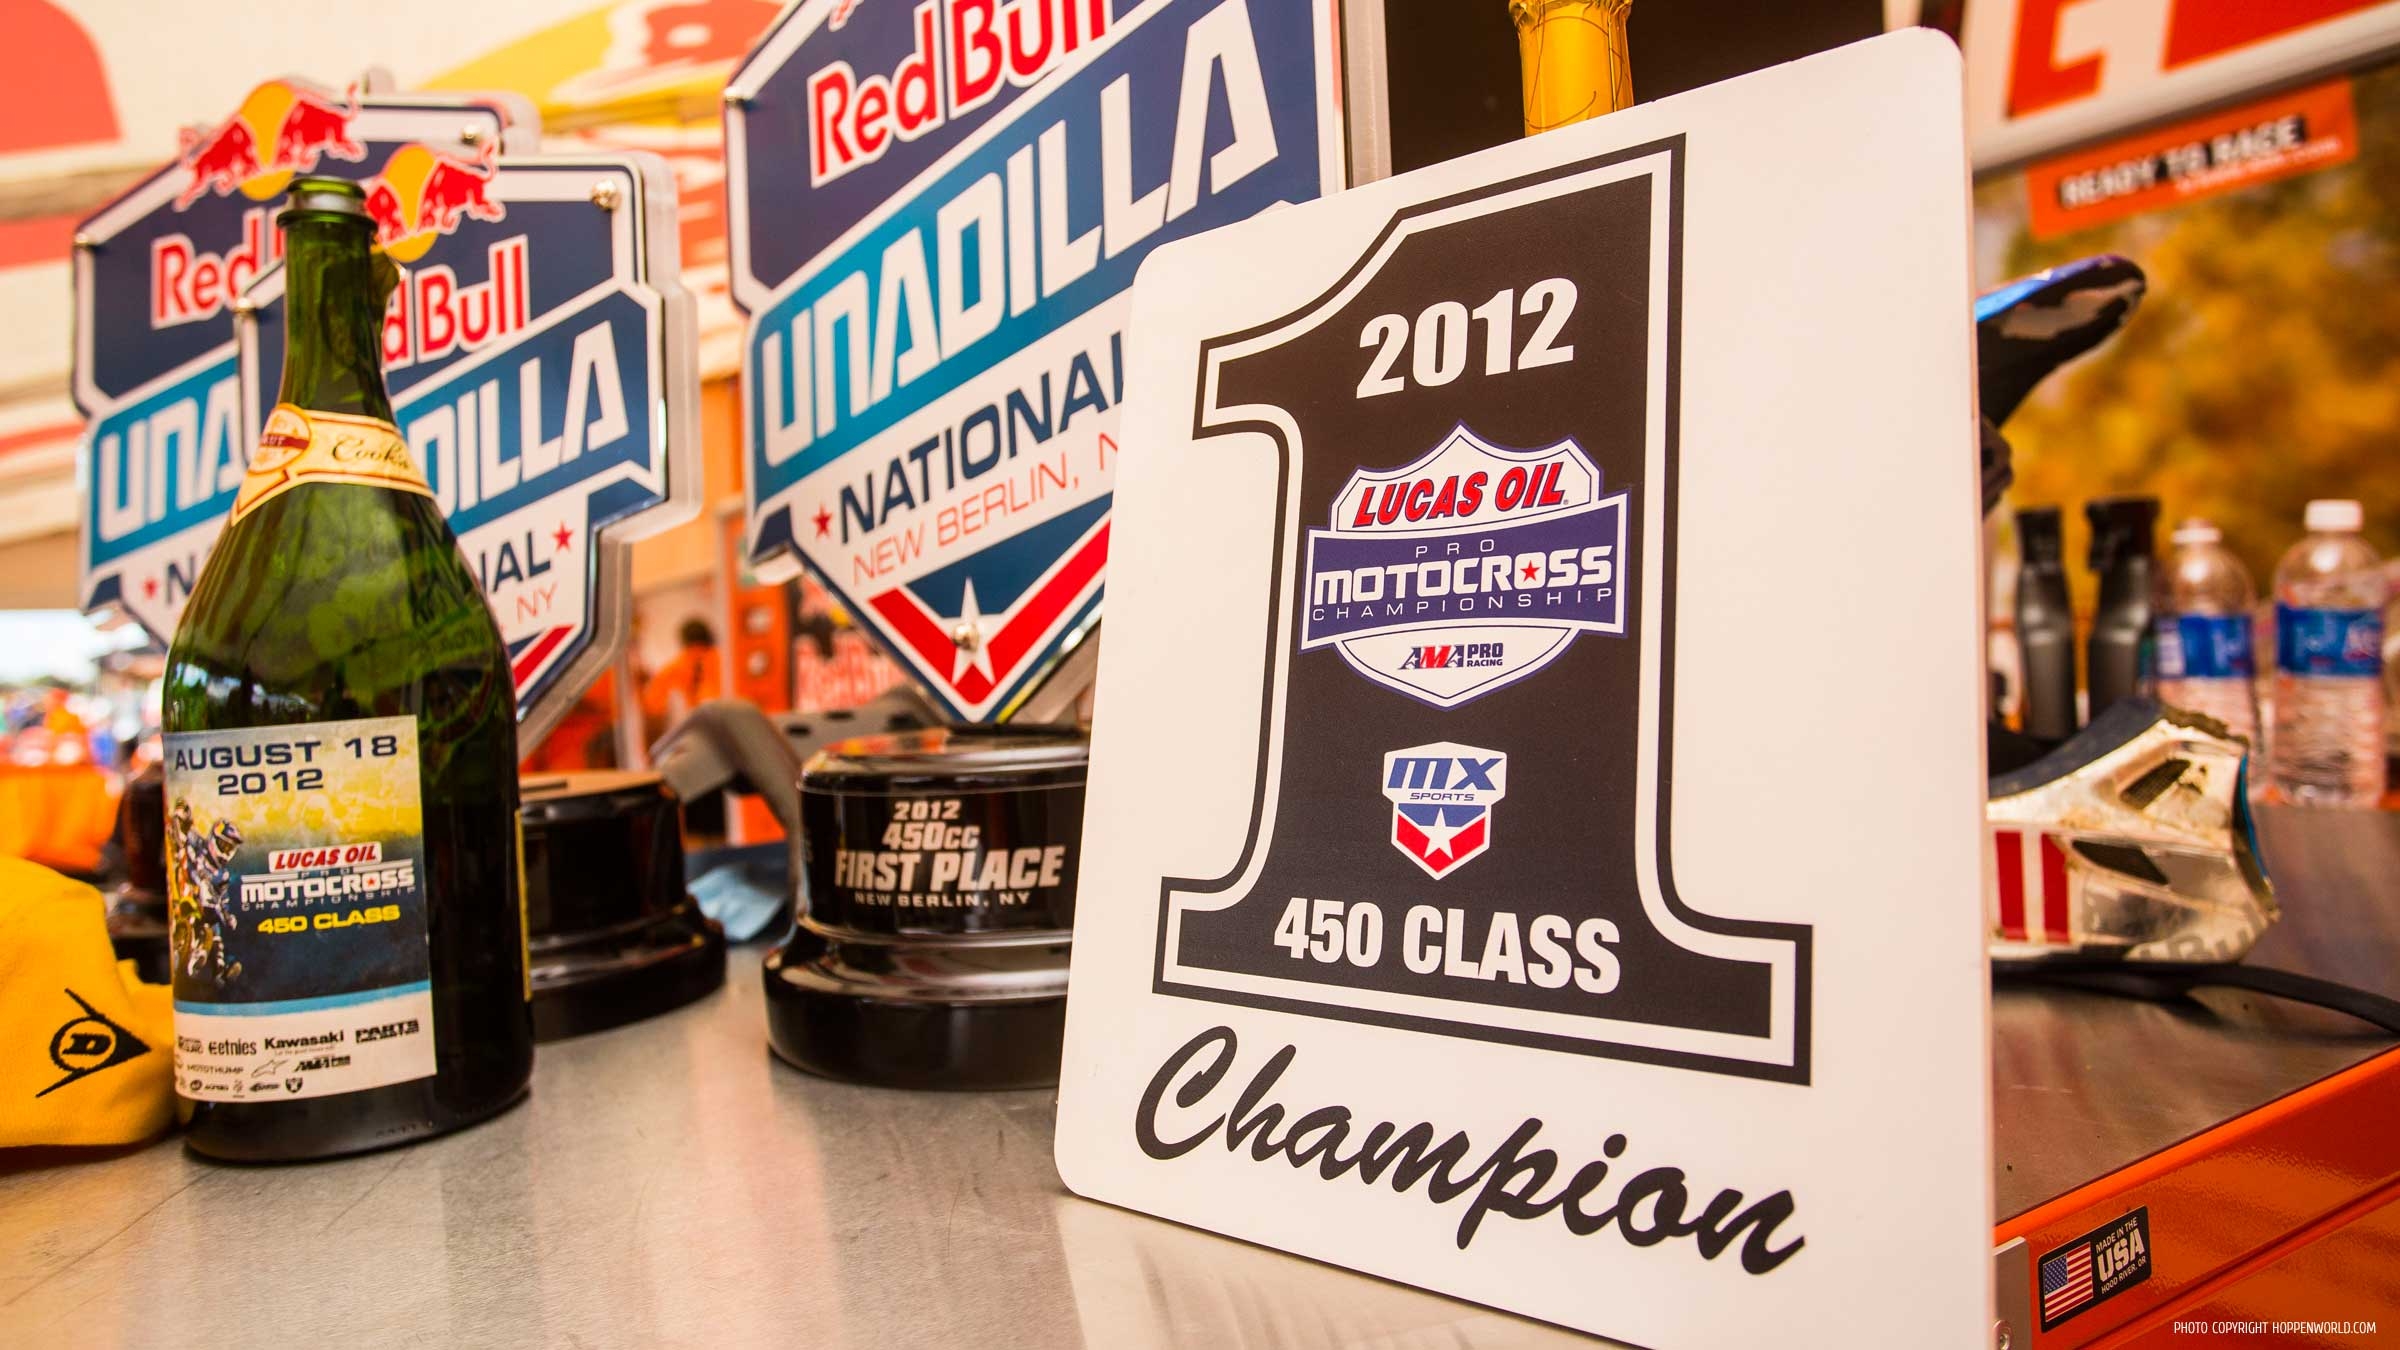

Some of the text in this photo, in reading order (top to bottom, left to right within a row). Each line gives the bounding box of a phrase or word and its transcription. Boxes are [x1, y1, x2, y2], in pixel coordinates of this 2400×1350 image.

[815, 7, 938, 177] Red
[762, 0, 1279, 466] UNADILLA
[420, 243, 525, 354] Bull
[1356, 277, 1578, 399] 2012
[1352, 461, 1566, 528] LUCAS OIL
[853, 520, 925, 586] NEW
[936, 451, 1080, 548] BERLIN,
[1415, 538, 1496, 559] PRO
[1312, 545, 1613, 606] MOTOCROSS
[517, 583, 558, 621] NY
[1312, 587, 1613, 622] CHAMPIONSHIP
[1398, 642, 1504, 670] AMA PRO
[1466, 658, 1504, 668] RACING
[175, 735, 398, 771] AUGUST 18
[217, 768, 324, 796] 2012
[1409, 792, 1475, 802] SPORTS
[893, 800, 962, 821] 2012
[275, 845, 377, 870] LUCAS OIL
[301, 867, 351, 880] PRO
[834, 845, 1067, 893] FIRST PLACE
[240, 865, 415, 904] MOTOCROSS
[241, 886, 416, 912] CHAMPIONSHIP
[854, 890, 1031, 908] NEW BERLIN, NY
[257, 903, 401, 935] 450 CLASS
[1273, 896, 1621, 994] 450 CLASS
[265, 1029, 345, 1050] Kawasaki
[1135, 1025, 1806, 1276] Champion
[2095, 1216, 2139, 1254] MADE IN THE
[2097, 1228, 2146, 1282] USA
[2101, 1276, 2118, 1295] HOOD
[2138, 1255, 2147, 1268] OR
